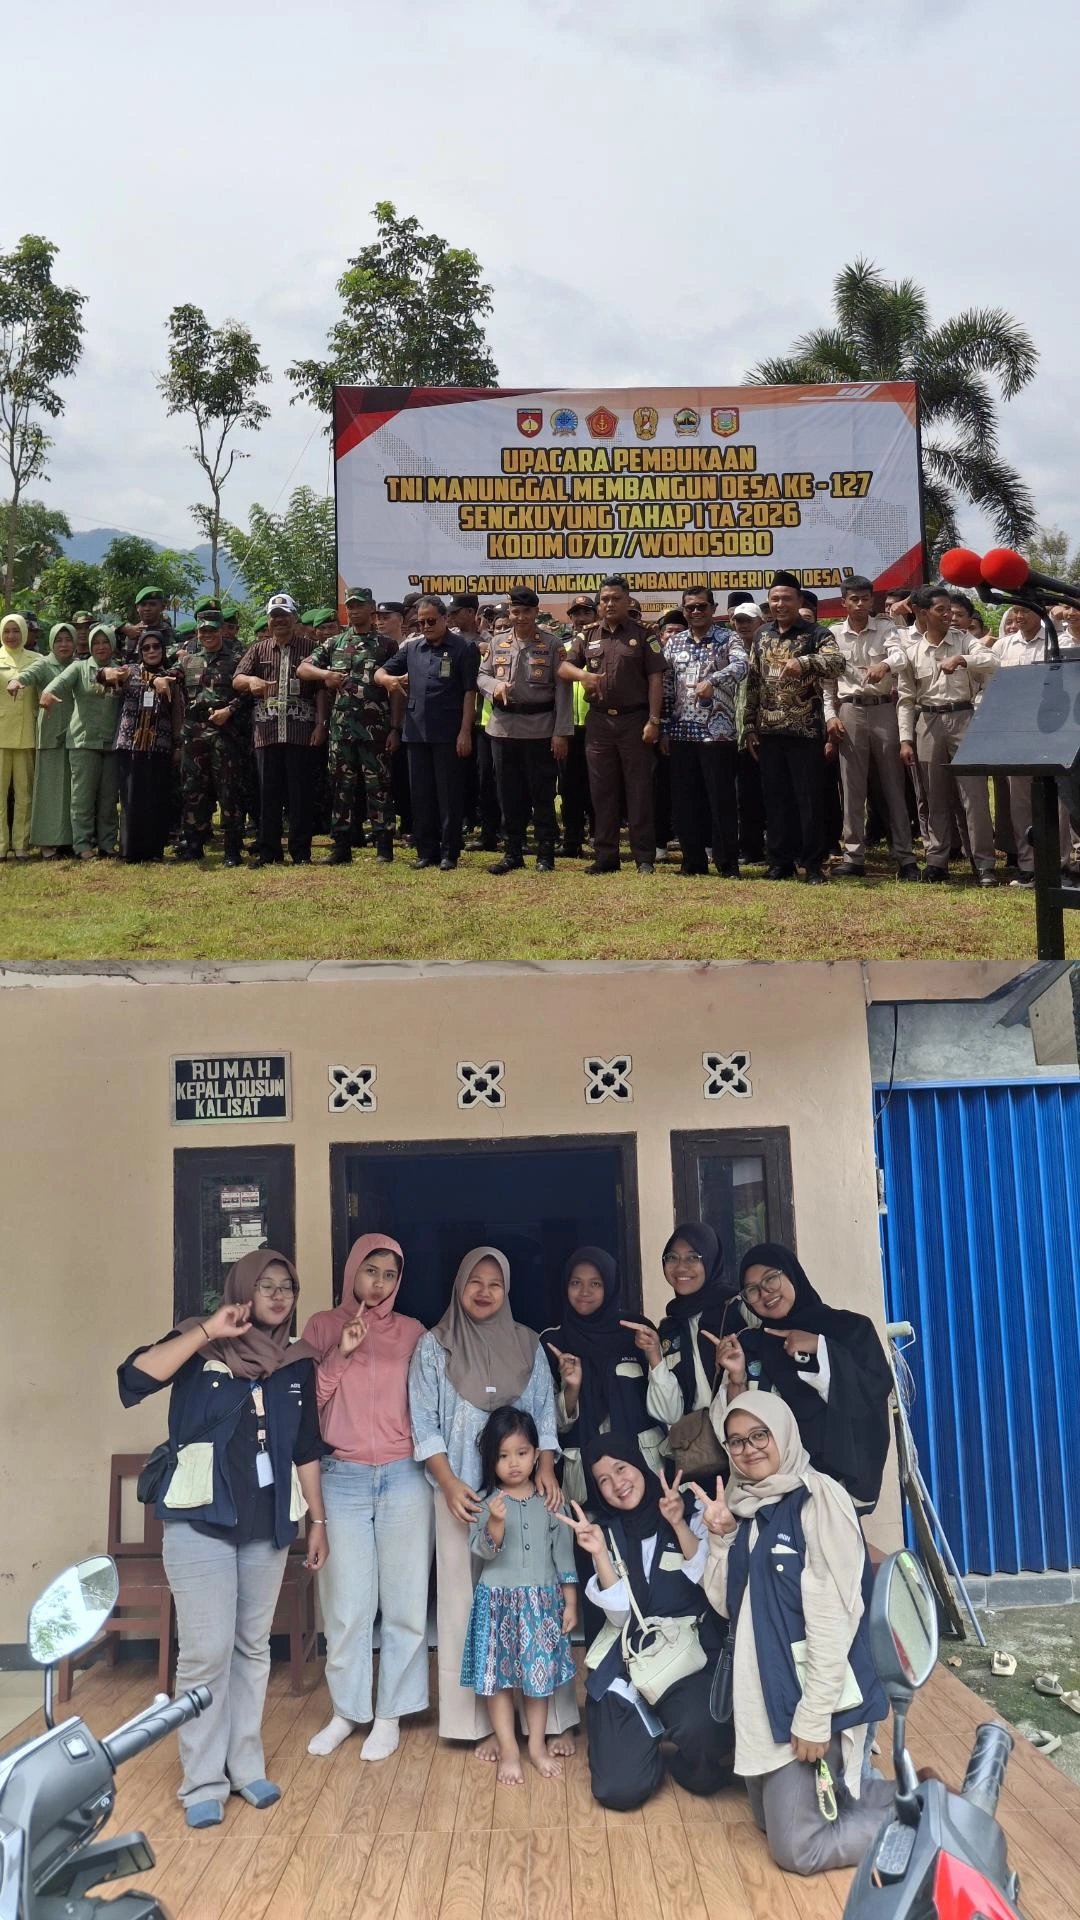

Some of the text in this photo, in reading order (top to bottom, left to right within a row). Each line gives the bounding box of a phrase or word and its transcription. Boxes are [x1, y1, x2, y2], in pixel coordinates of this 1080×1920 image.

[501, 446, 756, 474] UPACARA PEMBUKAAN
[385, 476, 425, 501] TNI
[426, 476, 571, 502] MANUNGGAL
[571, 474, 718, 501] MEMBANGUN
[719, 473, 781, 499] DESA
[782, 473, 815, 499] KE
[830, 471, 873, 498] 127
[459, 501, 801, 531] SENGKUYUNG TAHAP I TA 2026
[487, 530, 773, 559] KODIM 0707/WONOSOBO
[467, 575, 536, 594] SATUKAN
[613, 572, 707, 591] EMBANGUN
[709, 570, 763, 590] NEGERI
[192, 1060, 271, 1080] RUMAH
[176, 1078, 285, 1100] KEPALA DUSUN
[195, 1097, 261, 1118] KALISAT
